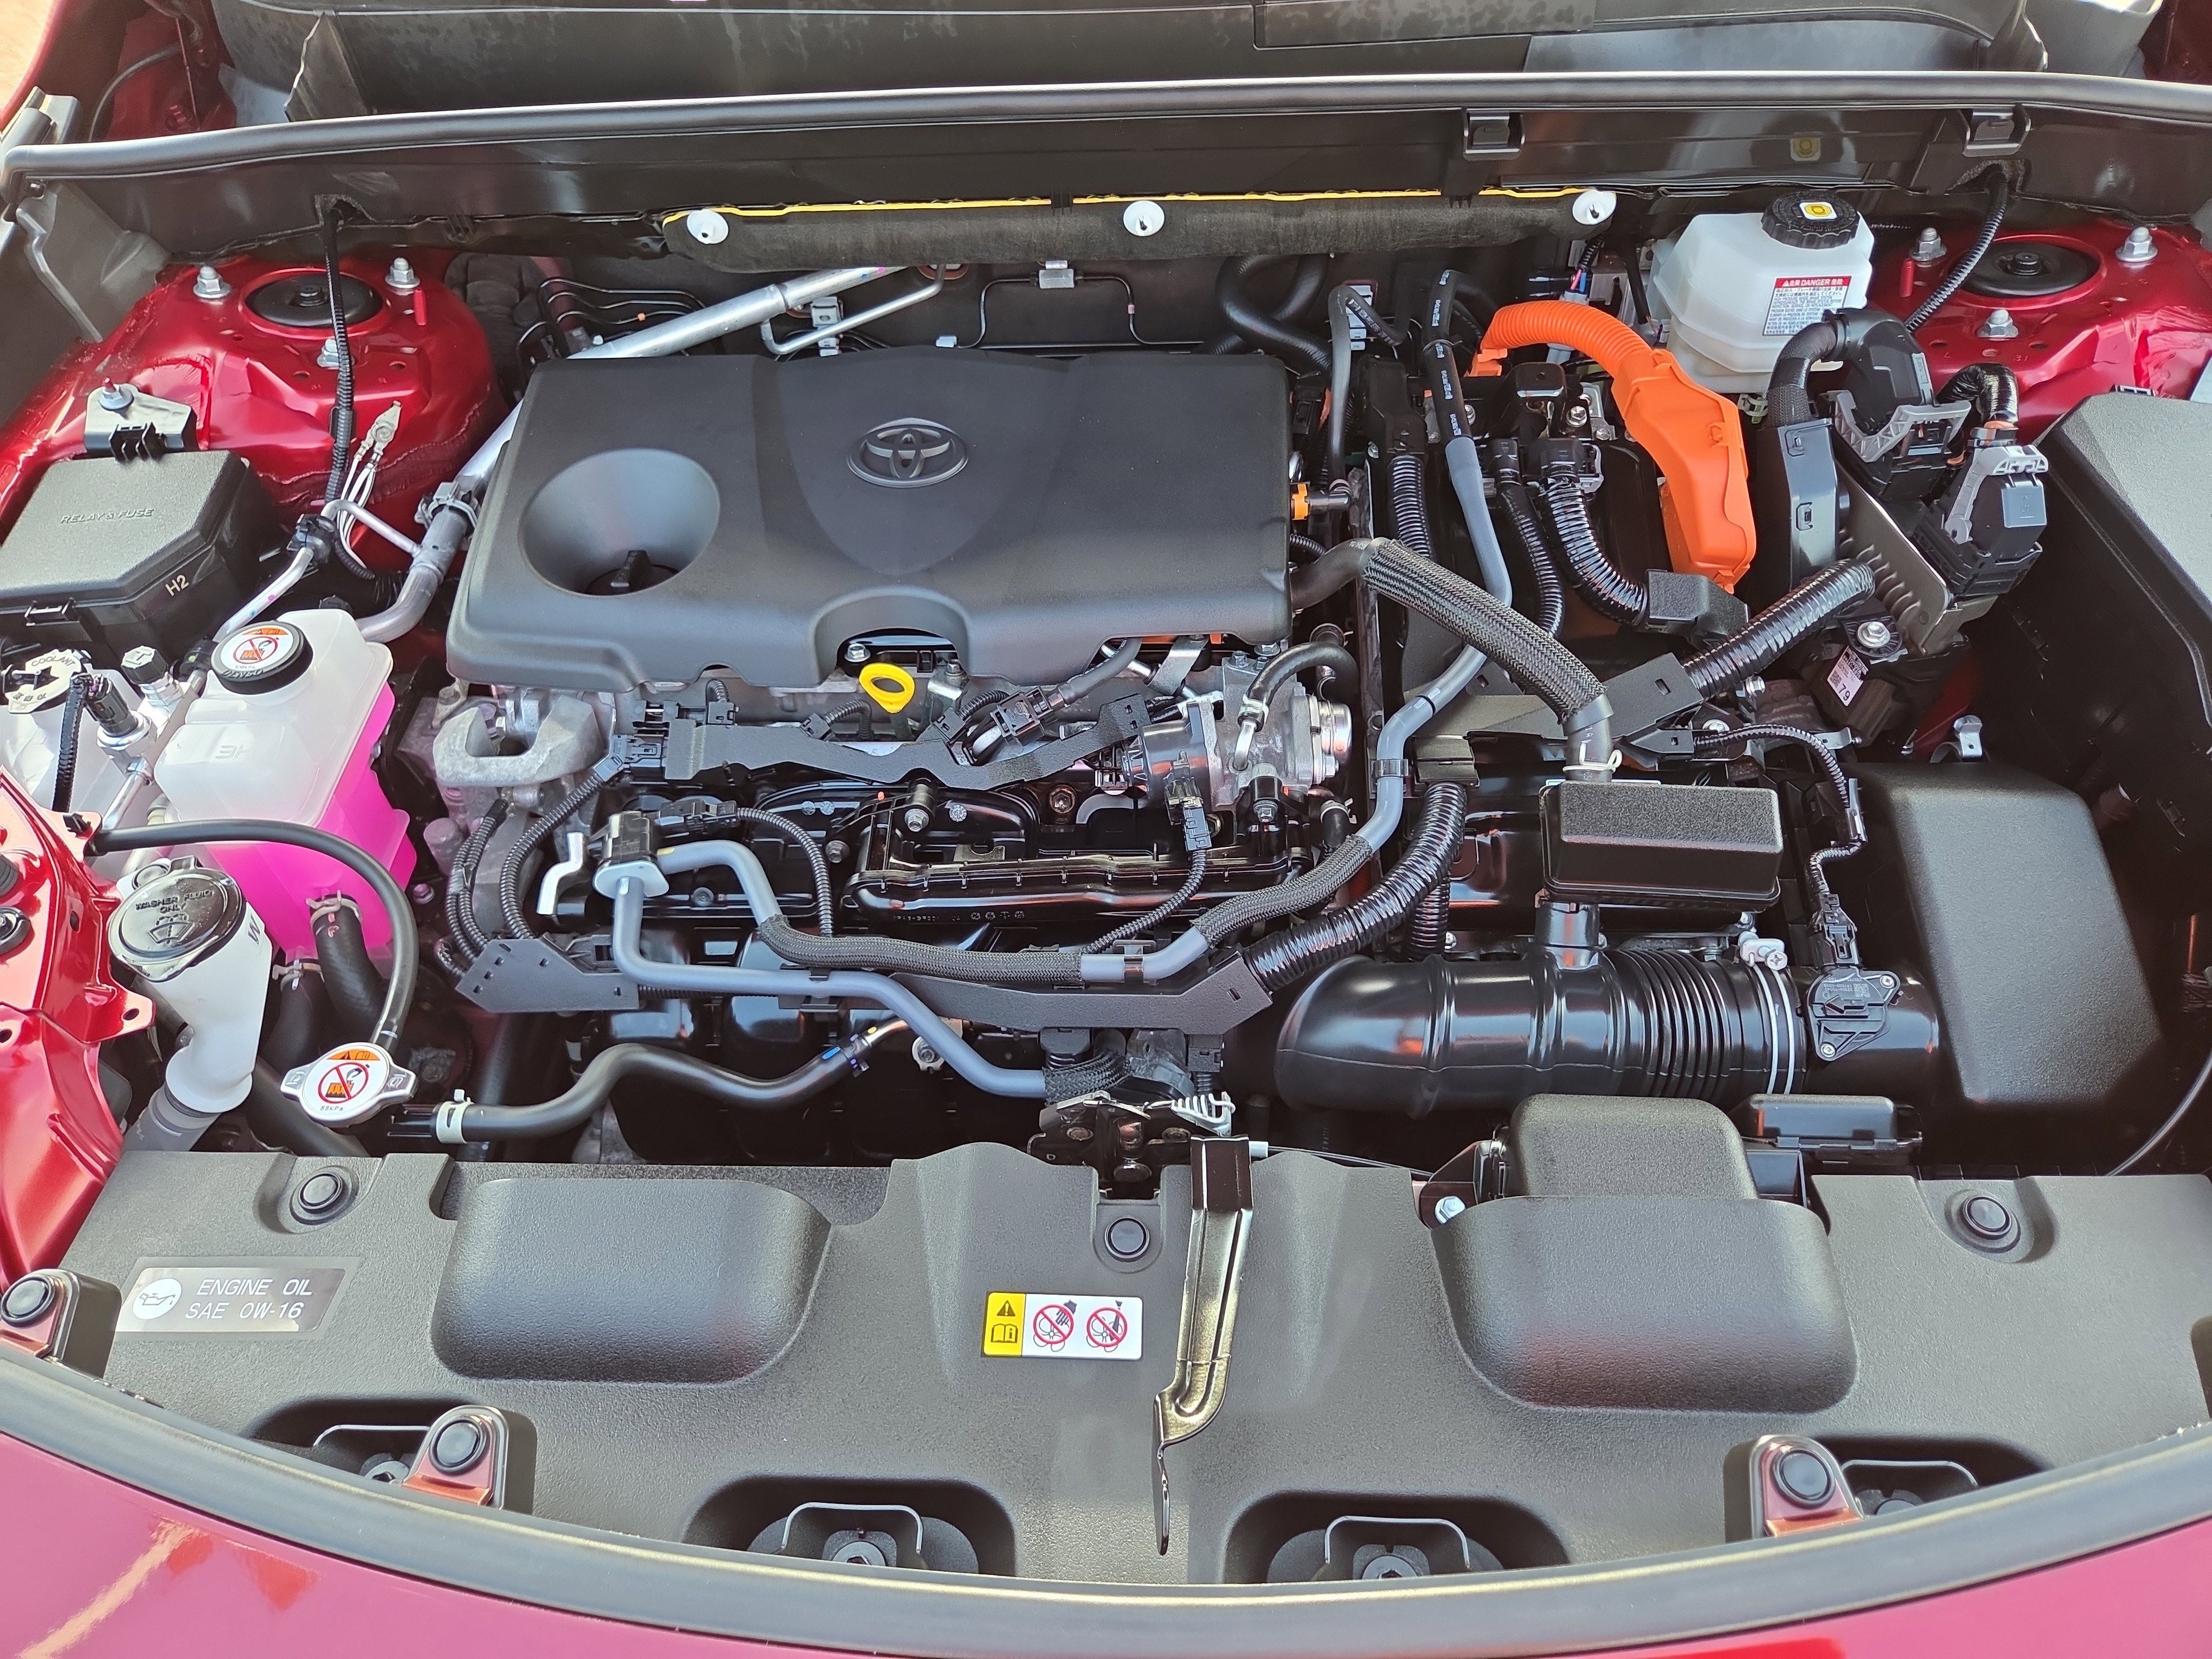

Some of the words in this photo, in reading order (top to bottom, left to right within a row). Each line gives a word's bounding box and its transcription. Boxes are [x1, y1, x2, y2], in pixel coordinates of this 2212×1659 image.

[1800, 278, 1830, 286] DANGER
[60, 512, 105, 524] RELAY
[106, 511, 115, 520] &
[118, 508, 155, 519] FUSE
[165, 575, 190, 597] H2
[31, 655, 76, 667] COOLANT
[1838, 683, 1850, 701] 79
[136, 895, 179, 910] WASHER
[183, 889, 213, 901] FLUID
[159, 902, 187, 914] ONLY
[196, 1278, 273, 1296] ENGINE
[282, 1278, 313, 1296] OIL
[185, 1302, 230, 1319] SAE
[239, 1302, 305, 1319] 0W-16
